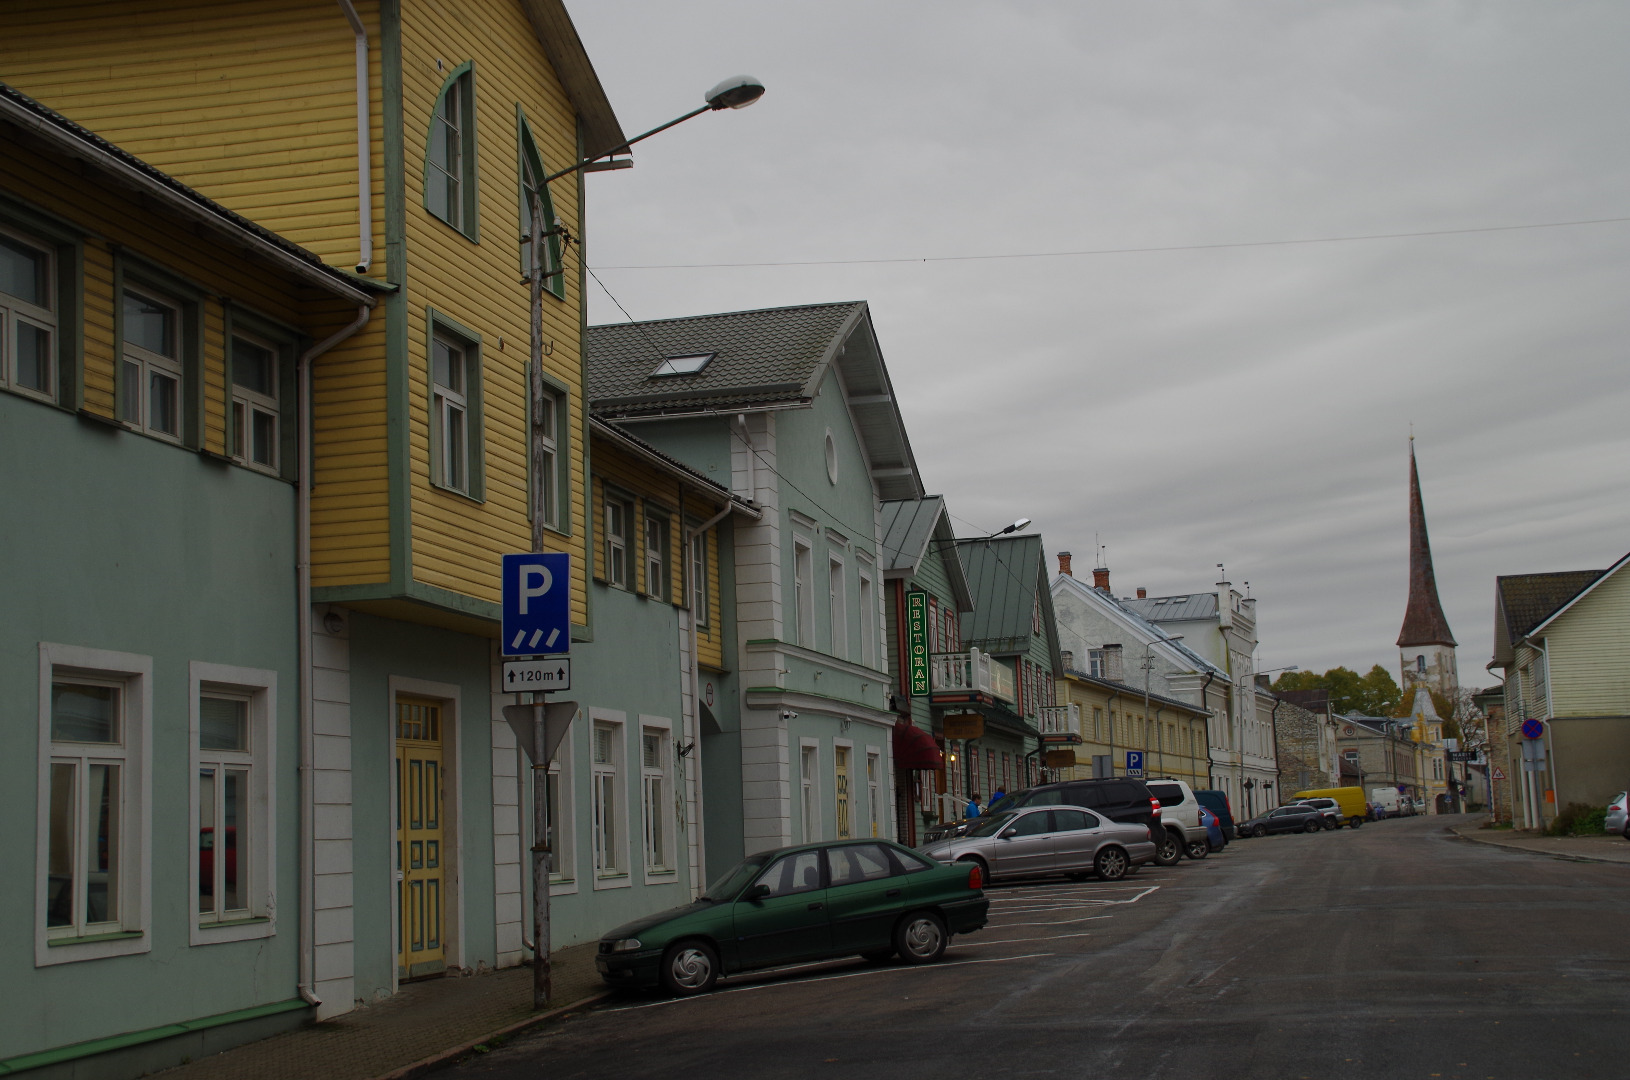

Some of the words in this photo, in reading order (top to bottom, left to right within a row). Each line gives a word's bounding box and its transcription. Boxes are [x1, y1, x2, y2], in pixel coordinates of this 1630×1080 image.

[519, 564, 553, 615] P
[911, 597, 926, 691] RESTORAN
[519, 670, 554, 681] 120m
[1130, 753, 1139, 767] P
